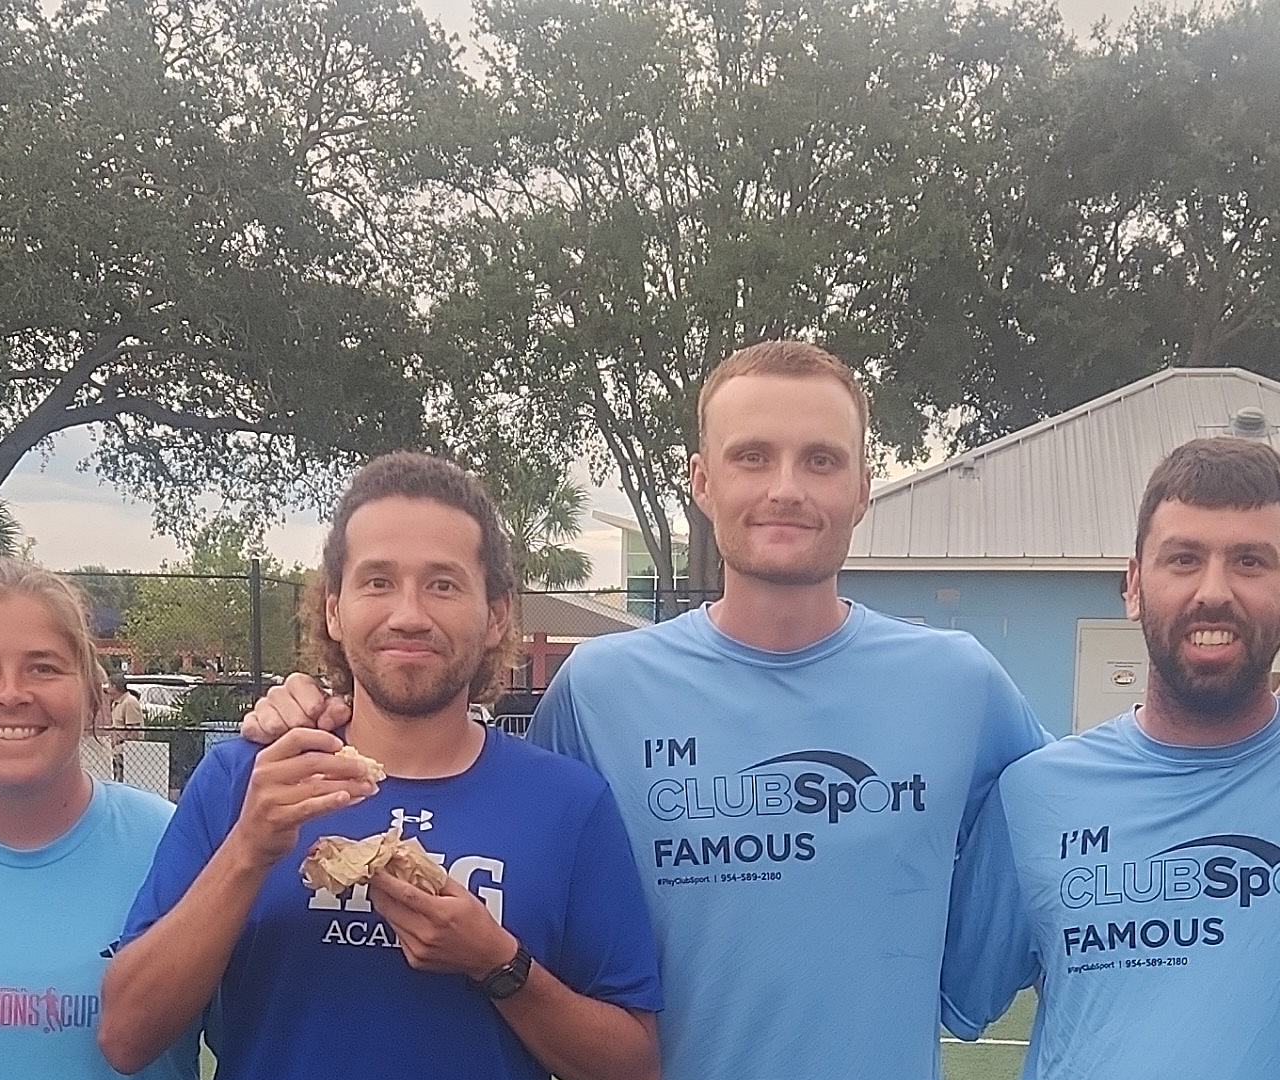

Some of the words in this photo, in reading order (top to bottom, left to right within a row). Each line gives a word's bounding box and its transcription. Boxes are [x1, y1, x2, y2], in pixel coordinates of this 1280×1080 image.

[644, 737, 697, 768] I'M
[647, 772, 926, 824] CLUBSport
[654, 832, 816, 868] FAMOUS
[1060, 825, 1110, 859] I'M
[720, 872, 782, 883] 954-589-2180
[322, 919, 402, 949] ACA
[1063, 917, 1225, 956] FAMOUS
[1125, 956, 1188, 968] 954-589-2180
[60, 994, 99, 1028] CUP
